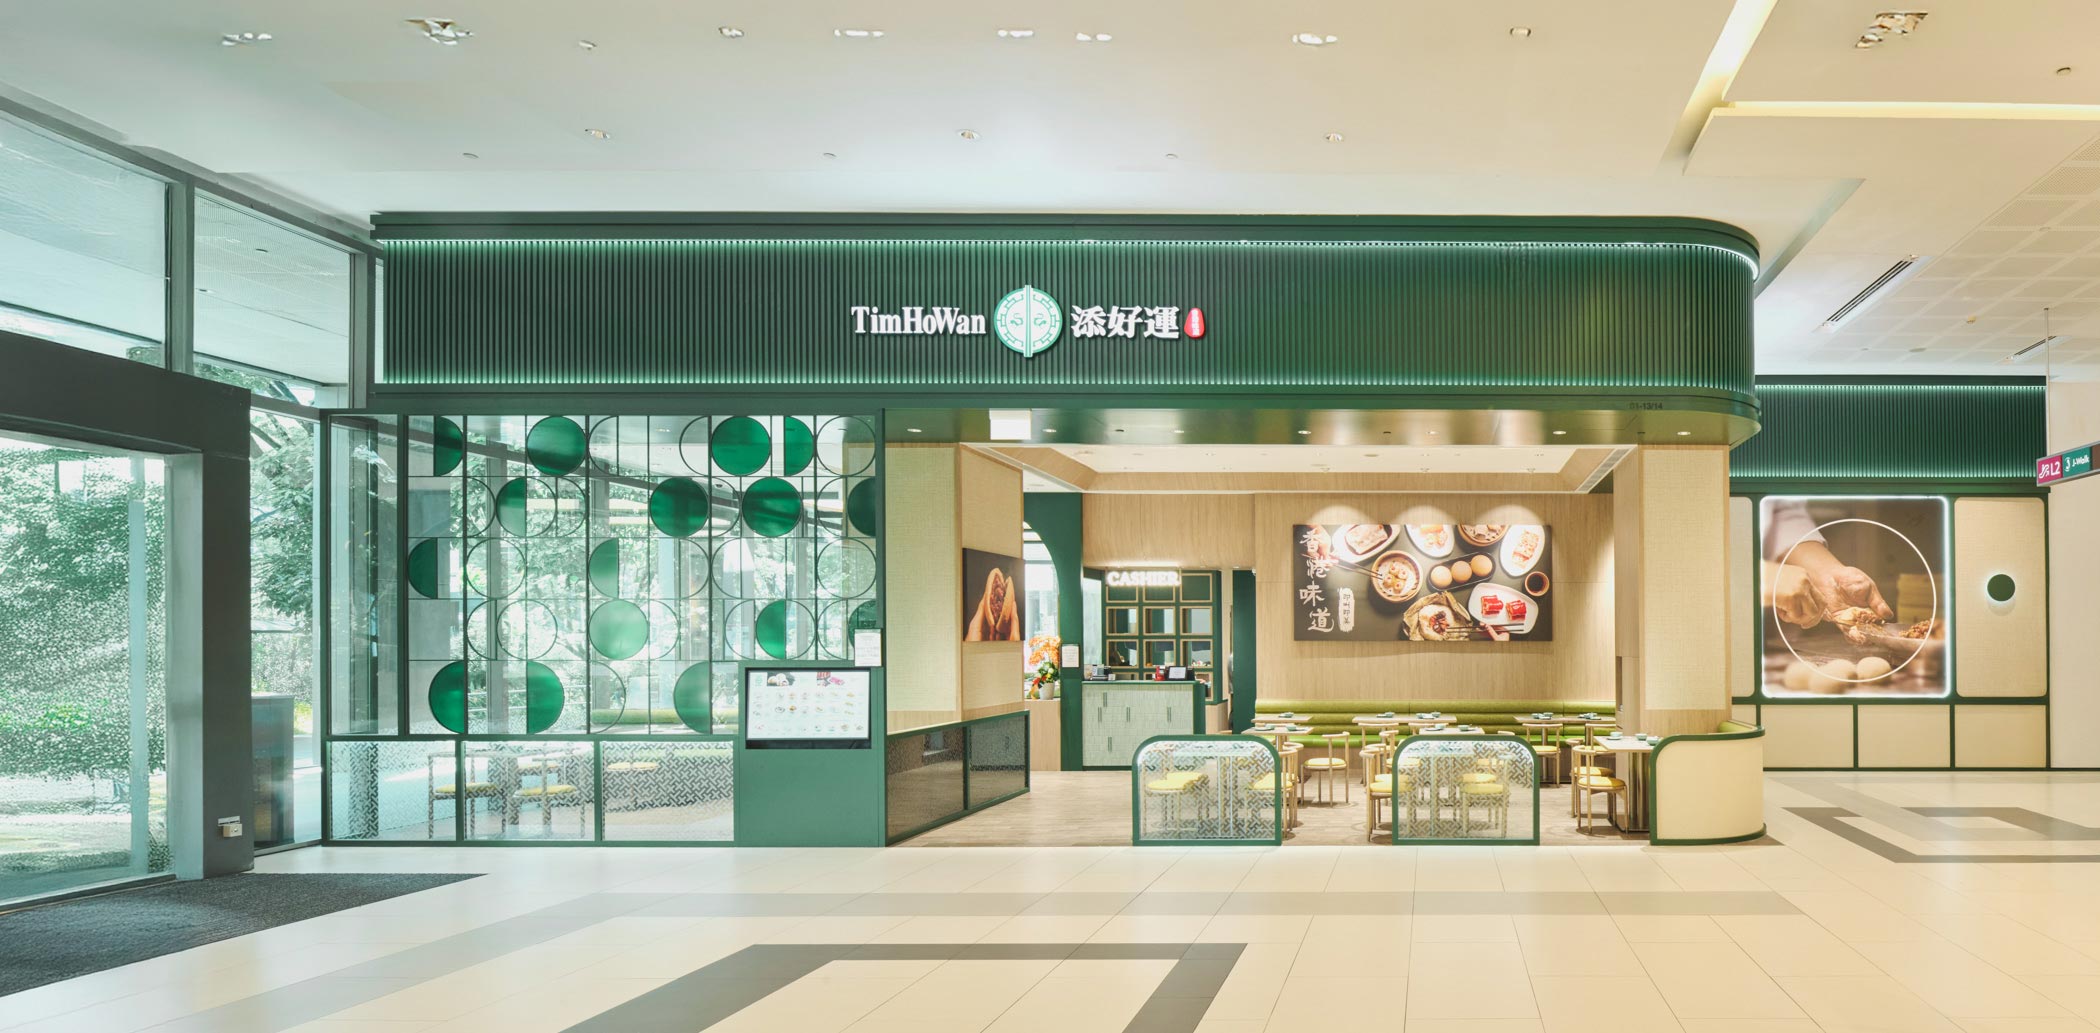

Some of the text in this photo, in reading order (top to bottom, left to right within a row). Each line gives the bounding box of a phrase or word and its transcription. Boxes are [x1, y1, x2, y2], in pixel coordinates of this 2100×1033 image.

[851, 306, 986, 335] TimHoWan
[1071, 305, 1180, 339] 添好運
[2050, 461, 2061, 476] L2
[1106, 570, 1181, 587] CASHIER
